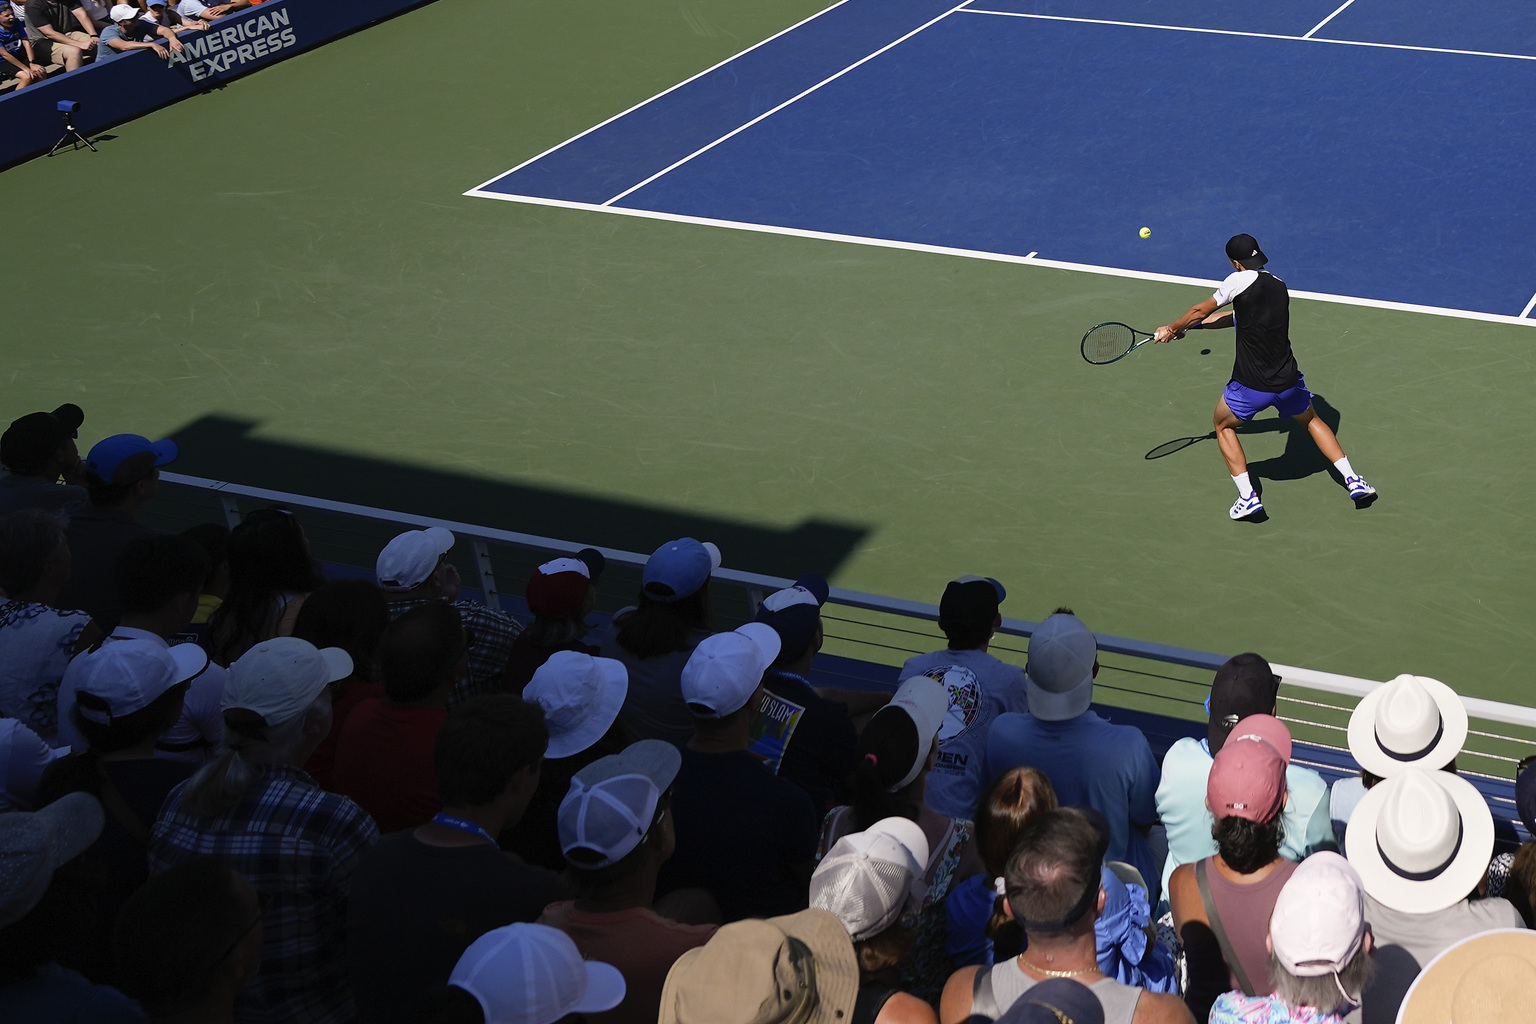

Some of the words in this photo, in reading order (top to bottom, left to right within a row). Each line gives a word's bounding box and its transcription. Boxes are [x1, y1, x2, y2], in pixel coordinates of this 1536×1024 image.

[167, 7, 291, 69] AMERICAN
[189, 27, 297, 83] EXPRESS
[938, 752, 969, 766] EN
